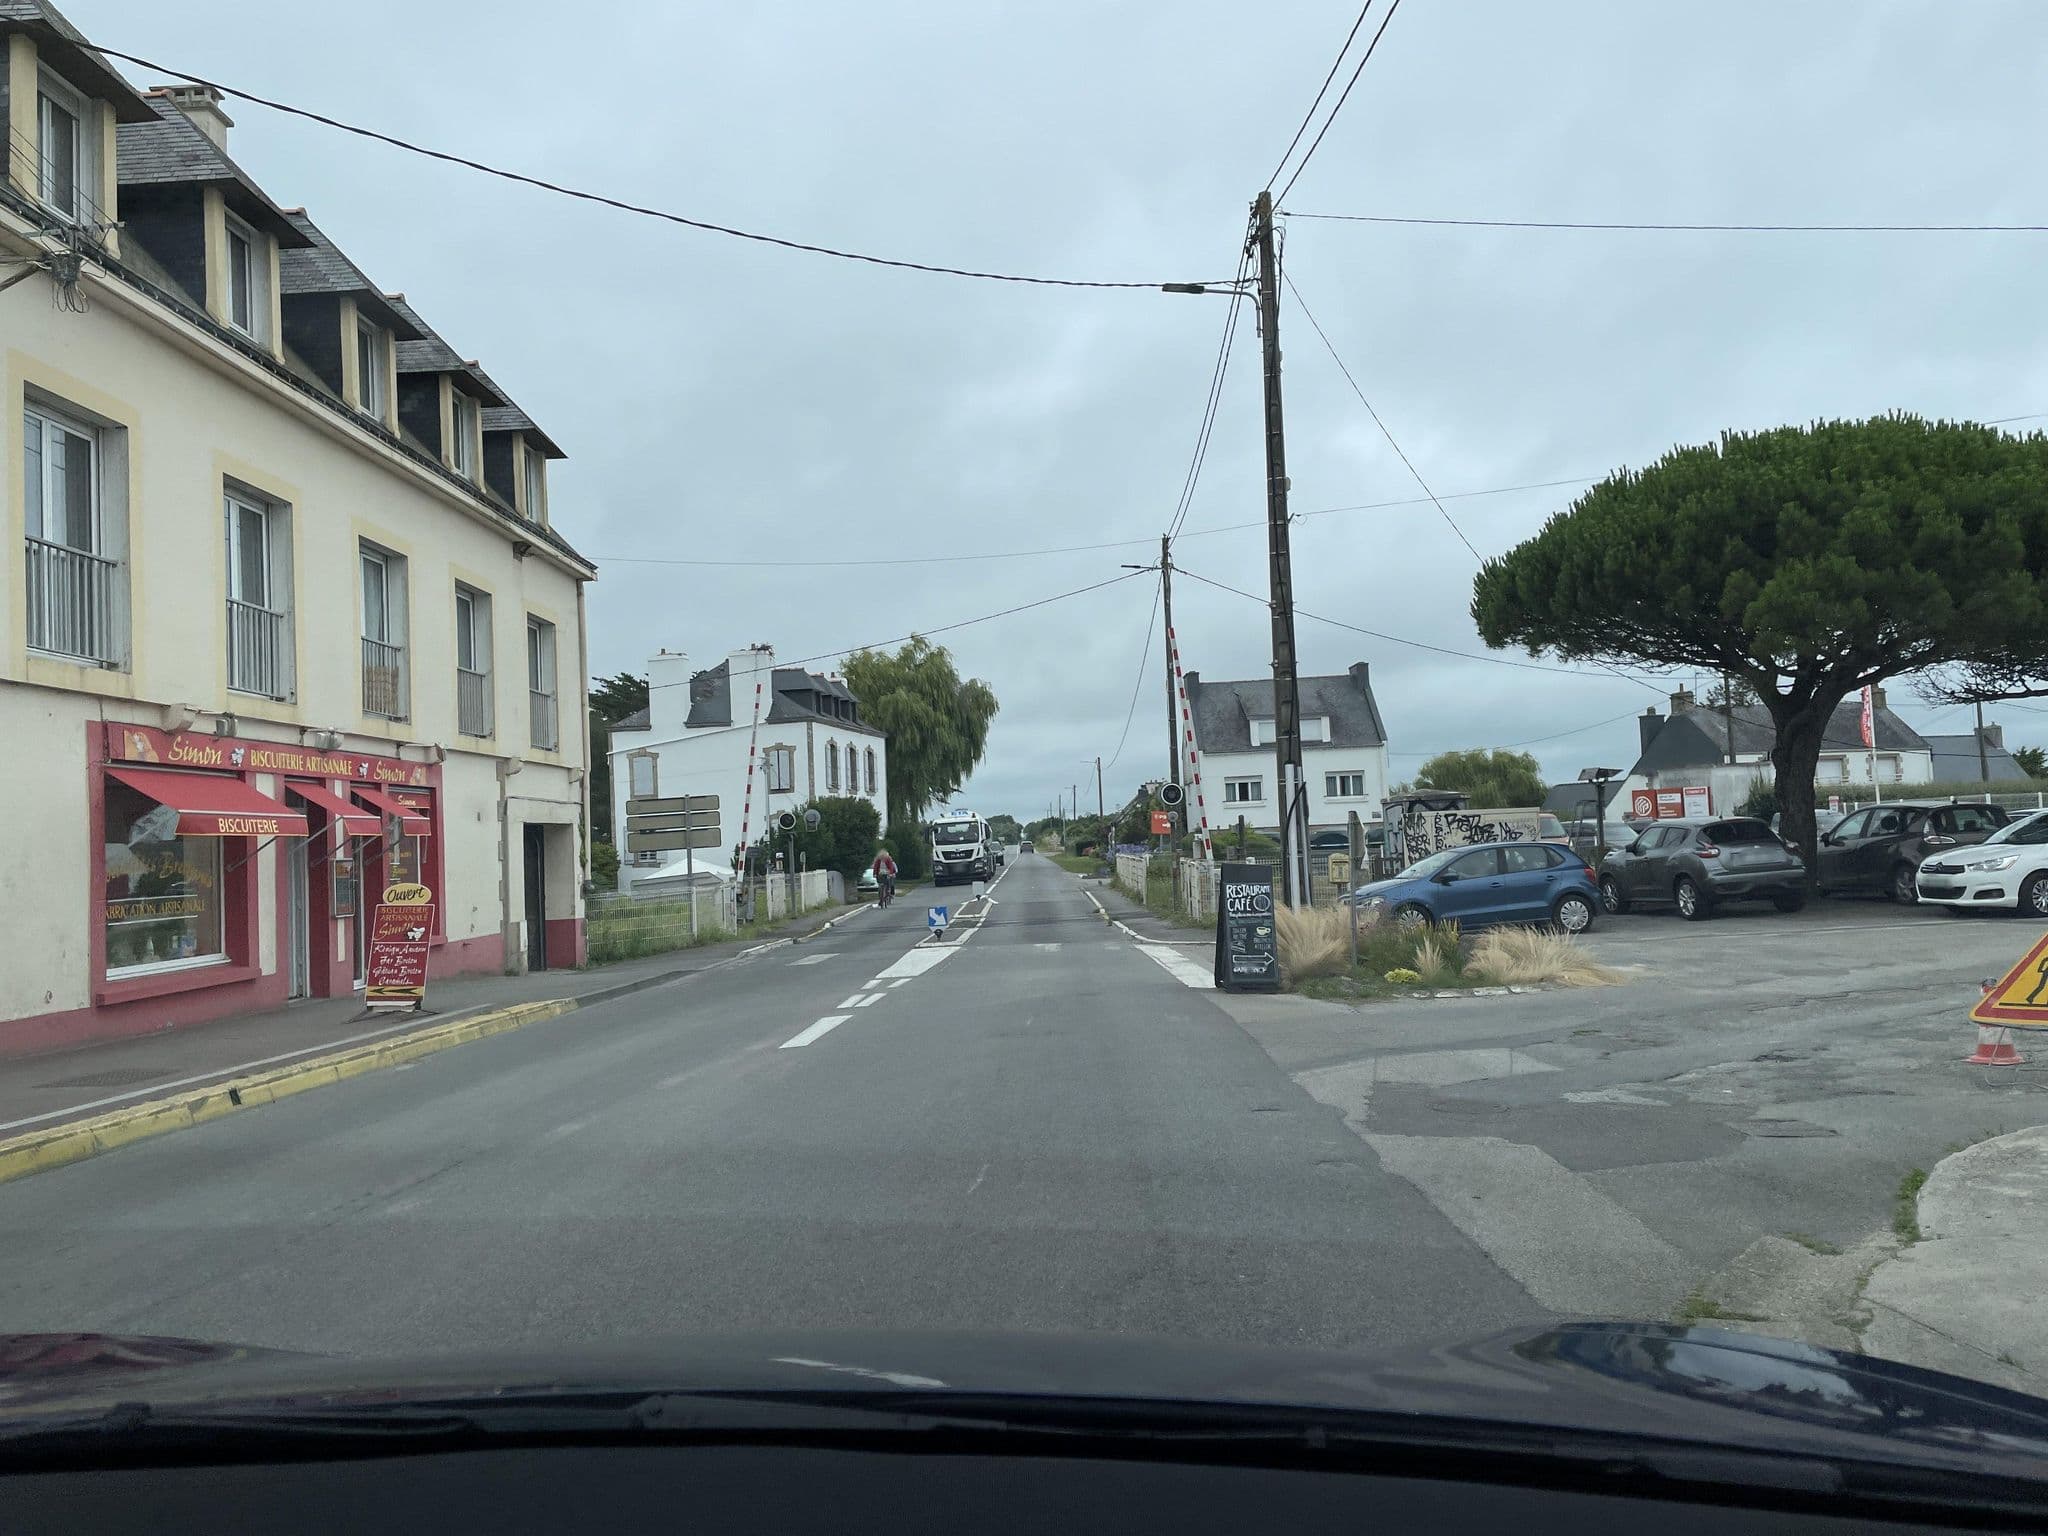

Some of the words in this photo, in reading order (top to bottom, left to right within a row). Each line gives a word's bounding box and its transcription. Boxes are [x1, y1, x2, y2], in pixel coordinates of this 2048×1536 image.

[168, 735, 222, 765] Simon
[250, 749, 304, 772] BISCUITERIE
[306, 755, 353, 776] ARTISANALE
[373, 760, 406, 782] Simon
[218, 818, 279, 833] BISCUITERIE
[387, 887, 425, 903] Ouvert
[1226, 884, 1271, 898] RESTAURANT
[1227, 896, 1252, 912] CAFÉ
